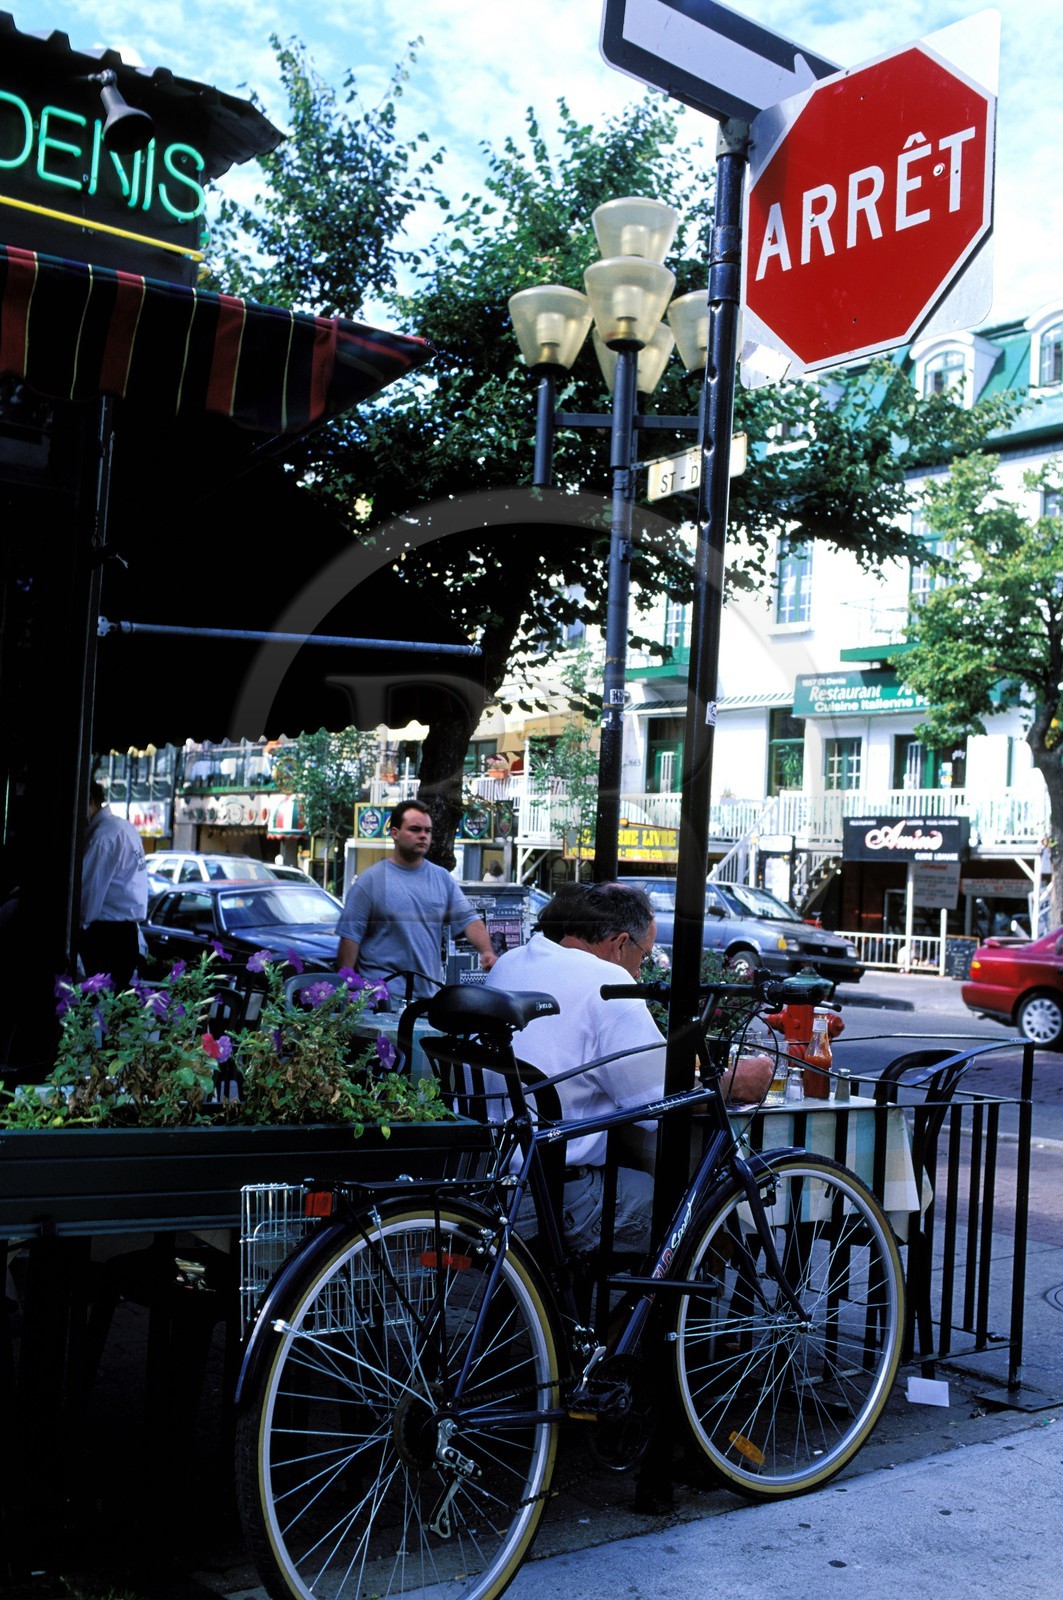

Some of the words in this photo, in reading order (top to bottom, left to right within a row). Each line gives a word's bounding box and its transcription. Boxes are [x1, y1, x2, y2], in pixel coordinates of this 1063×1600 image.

[755, 126, 977, 282] ARRÊT
[809, 684, 882, 702] Restaurant
[814, 700, 860, 713] Cuisine
[860, 697, 914, 711] Italienne
[539, 1002, 553, 1010] VELO
